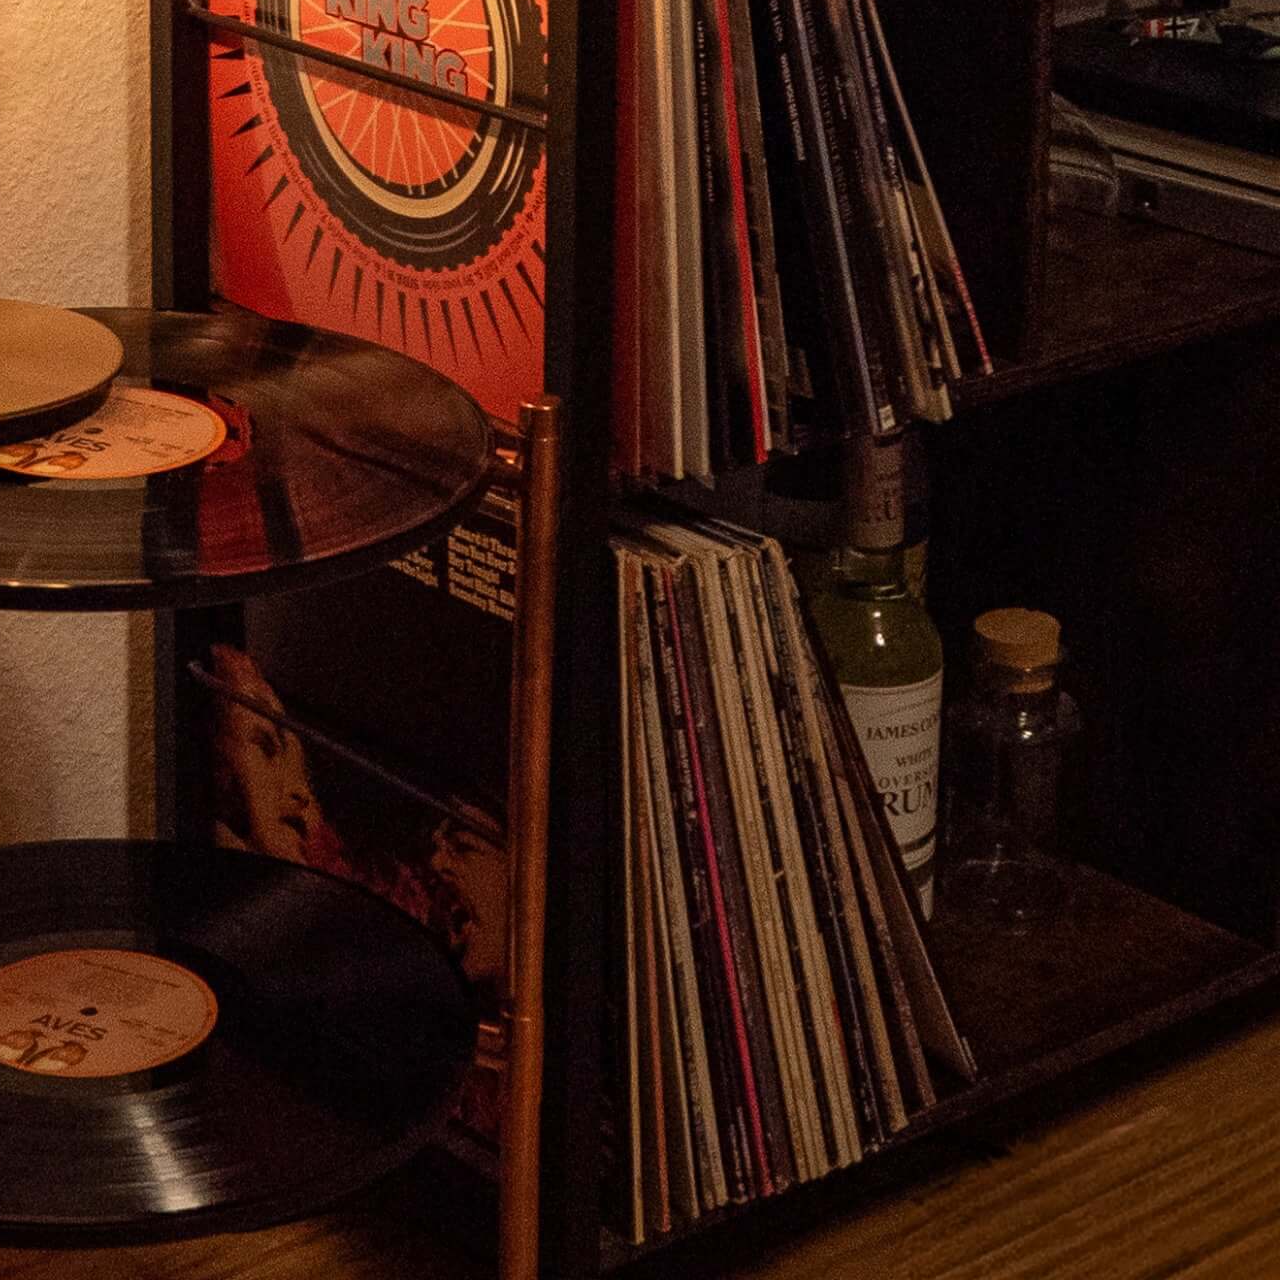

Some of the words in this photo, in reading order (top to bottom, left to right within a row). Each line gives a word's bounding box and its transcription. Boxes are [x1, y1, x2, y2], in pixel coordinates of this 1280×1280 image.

[361, 25, 469, 98] KING
[44, 433, 112, 453] VES
[867, 721, 919, 741] JAMES
[32, 1013, 108, 1042] AVES
